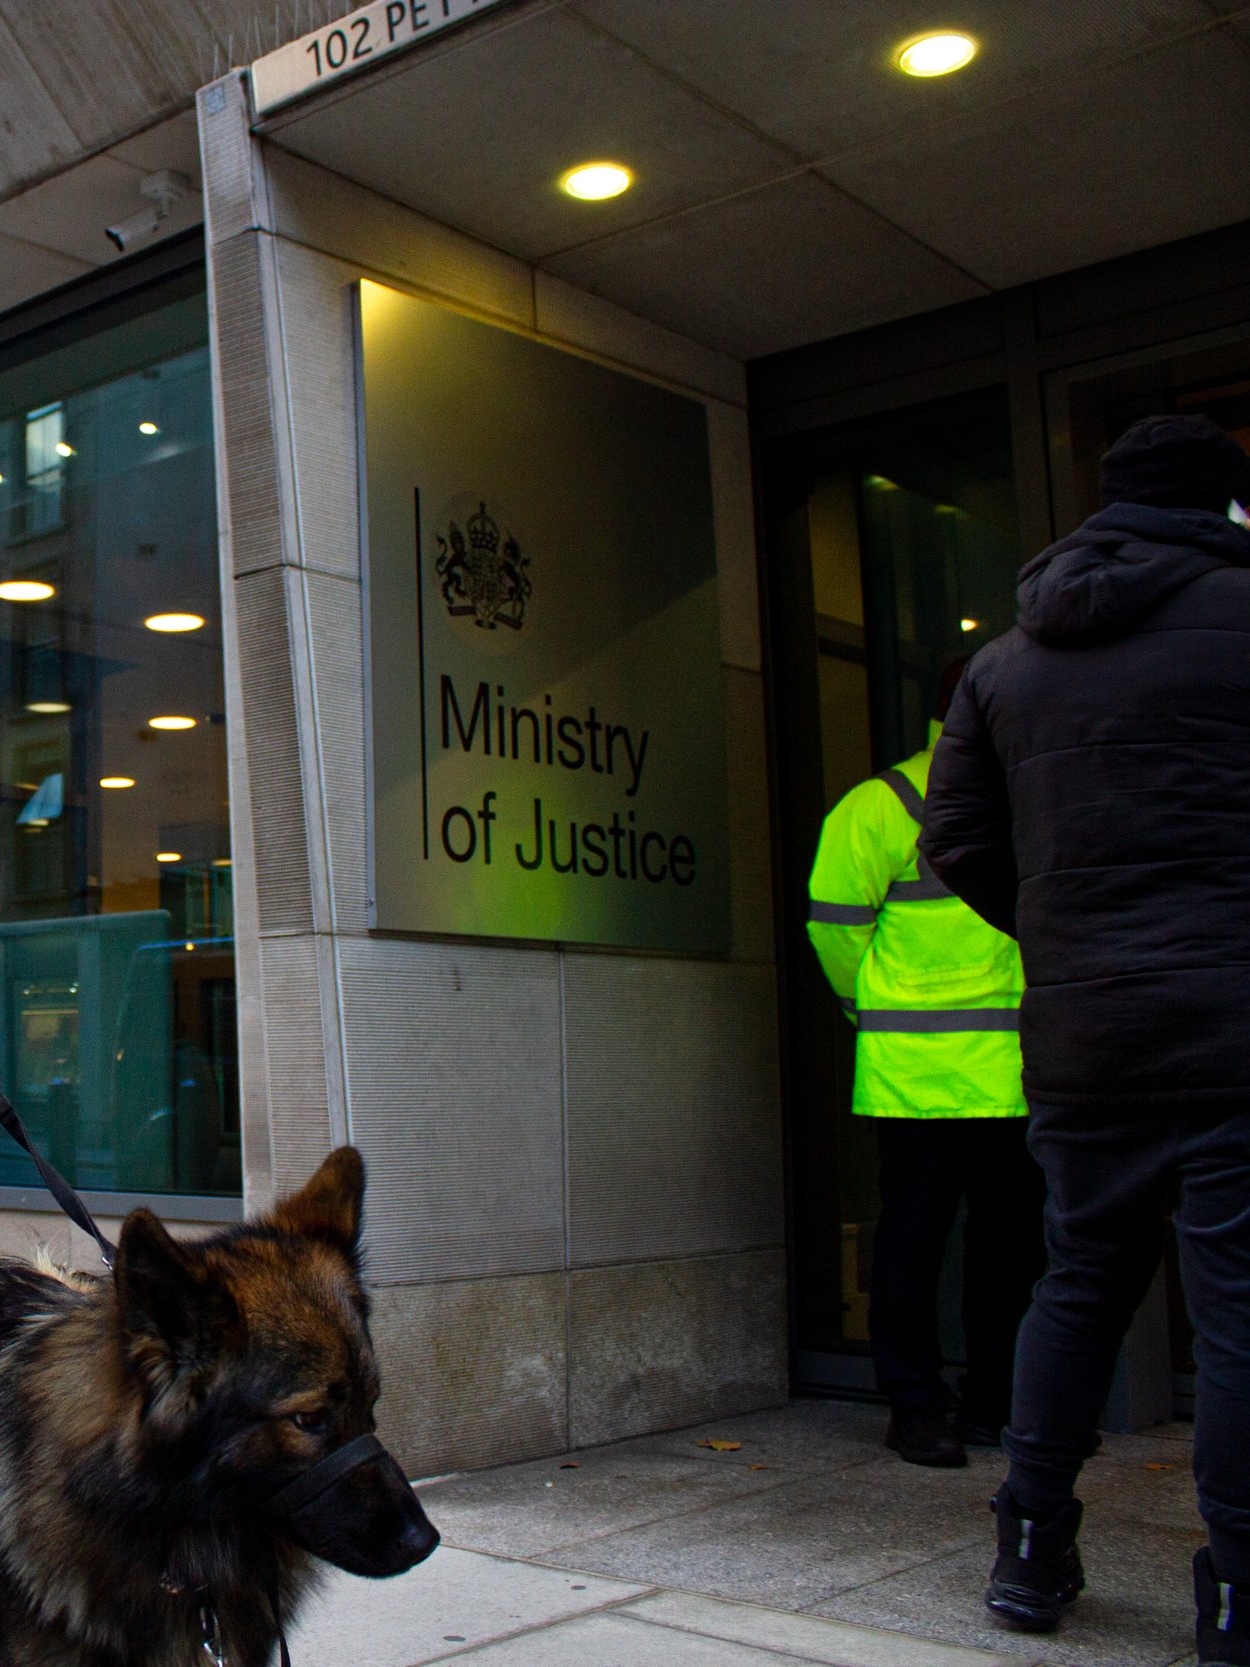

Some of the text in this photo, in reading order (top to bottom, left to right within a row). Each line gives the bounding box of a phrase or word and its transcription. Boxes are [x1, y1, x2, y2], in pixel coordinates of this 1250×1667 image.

[306, 16, 372, 76] 102
[440, 674, 649, 797] Ministry
[441, 791, 696, 887] of Justice
